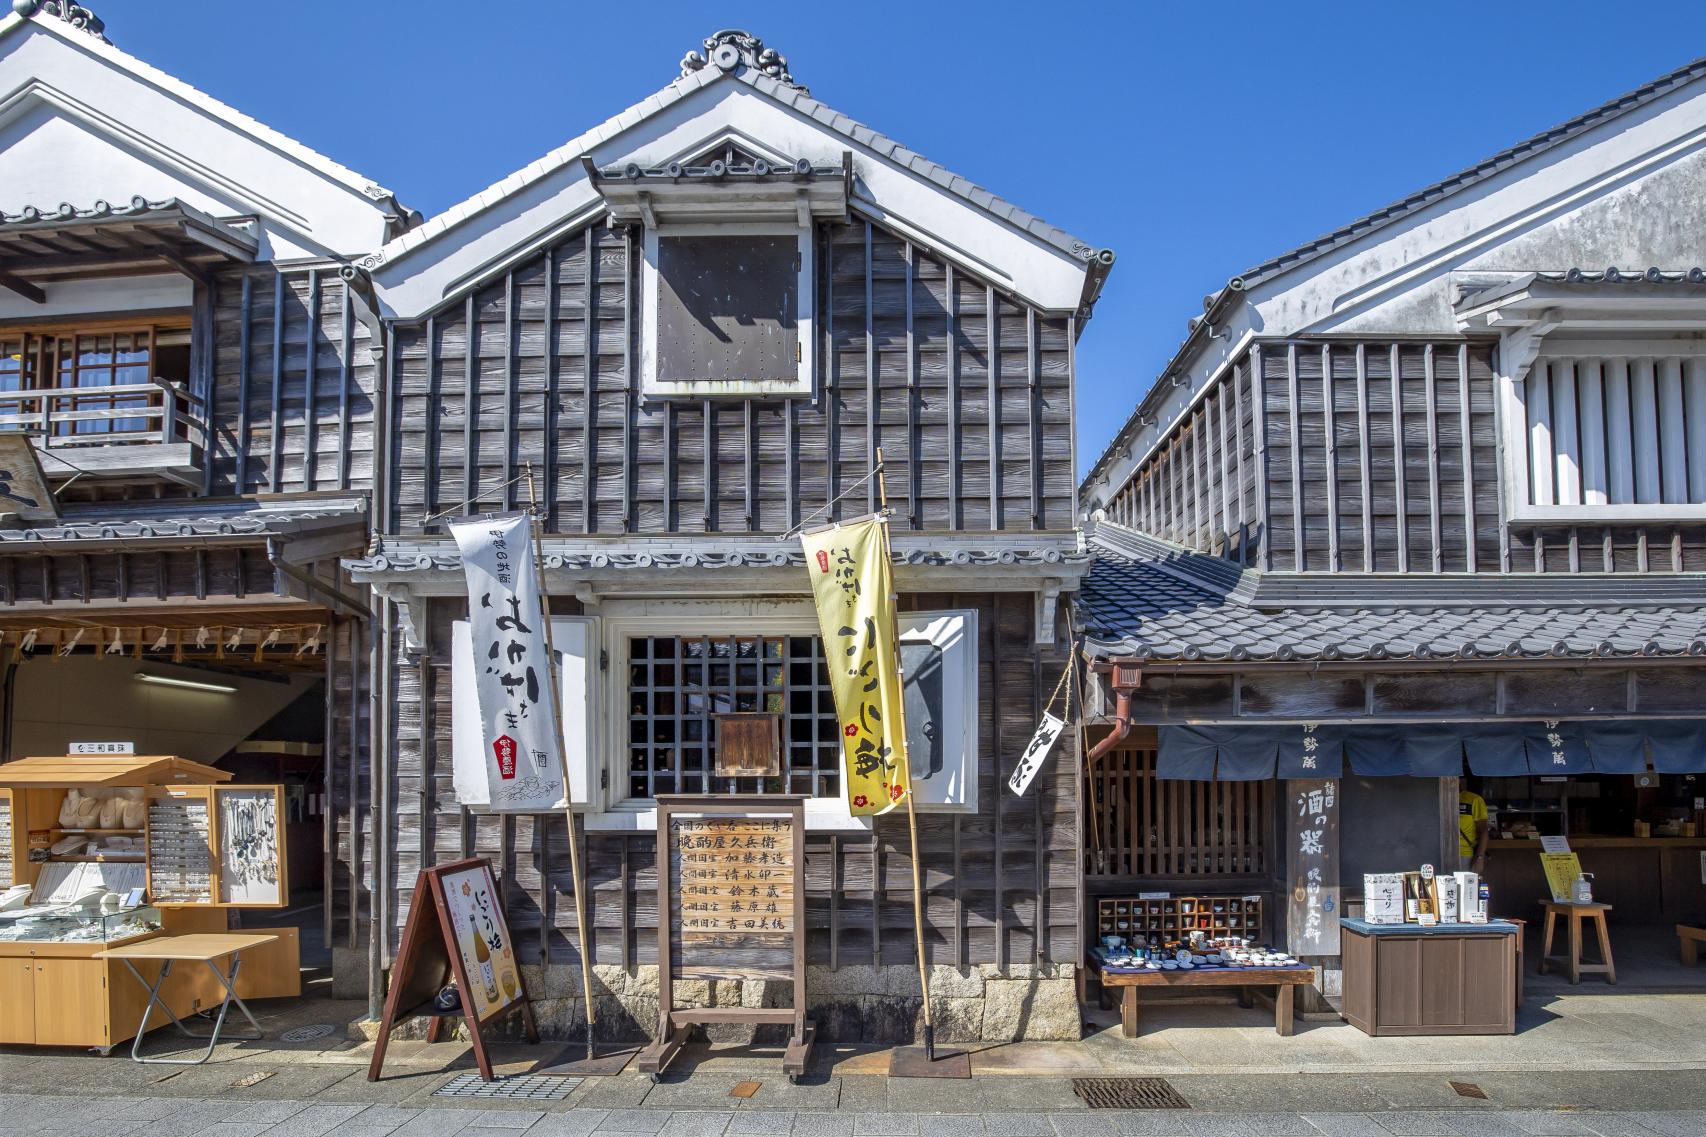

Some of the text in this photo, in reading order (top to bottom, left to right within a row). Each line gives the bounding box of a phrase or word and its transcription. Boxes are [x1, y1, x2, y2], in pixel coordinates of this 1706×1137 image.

[1297, 789, 1327, 855] 酒の器
[676, 835, 777, 850] 晩酌屋久兵衛
